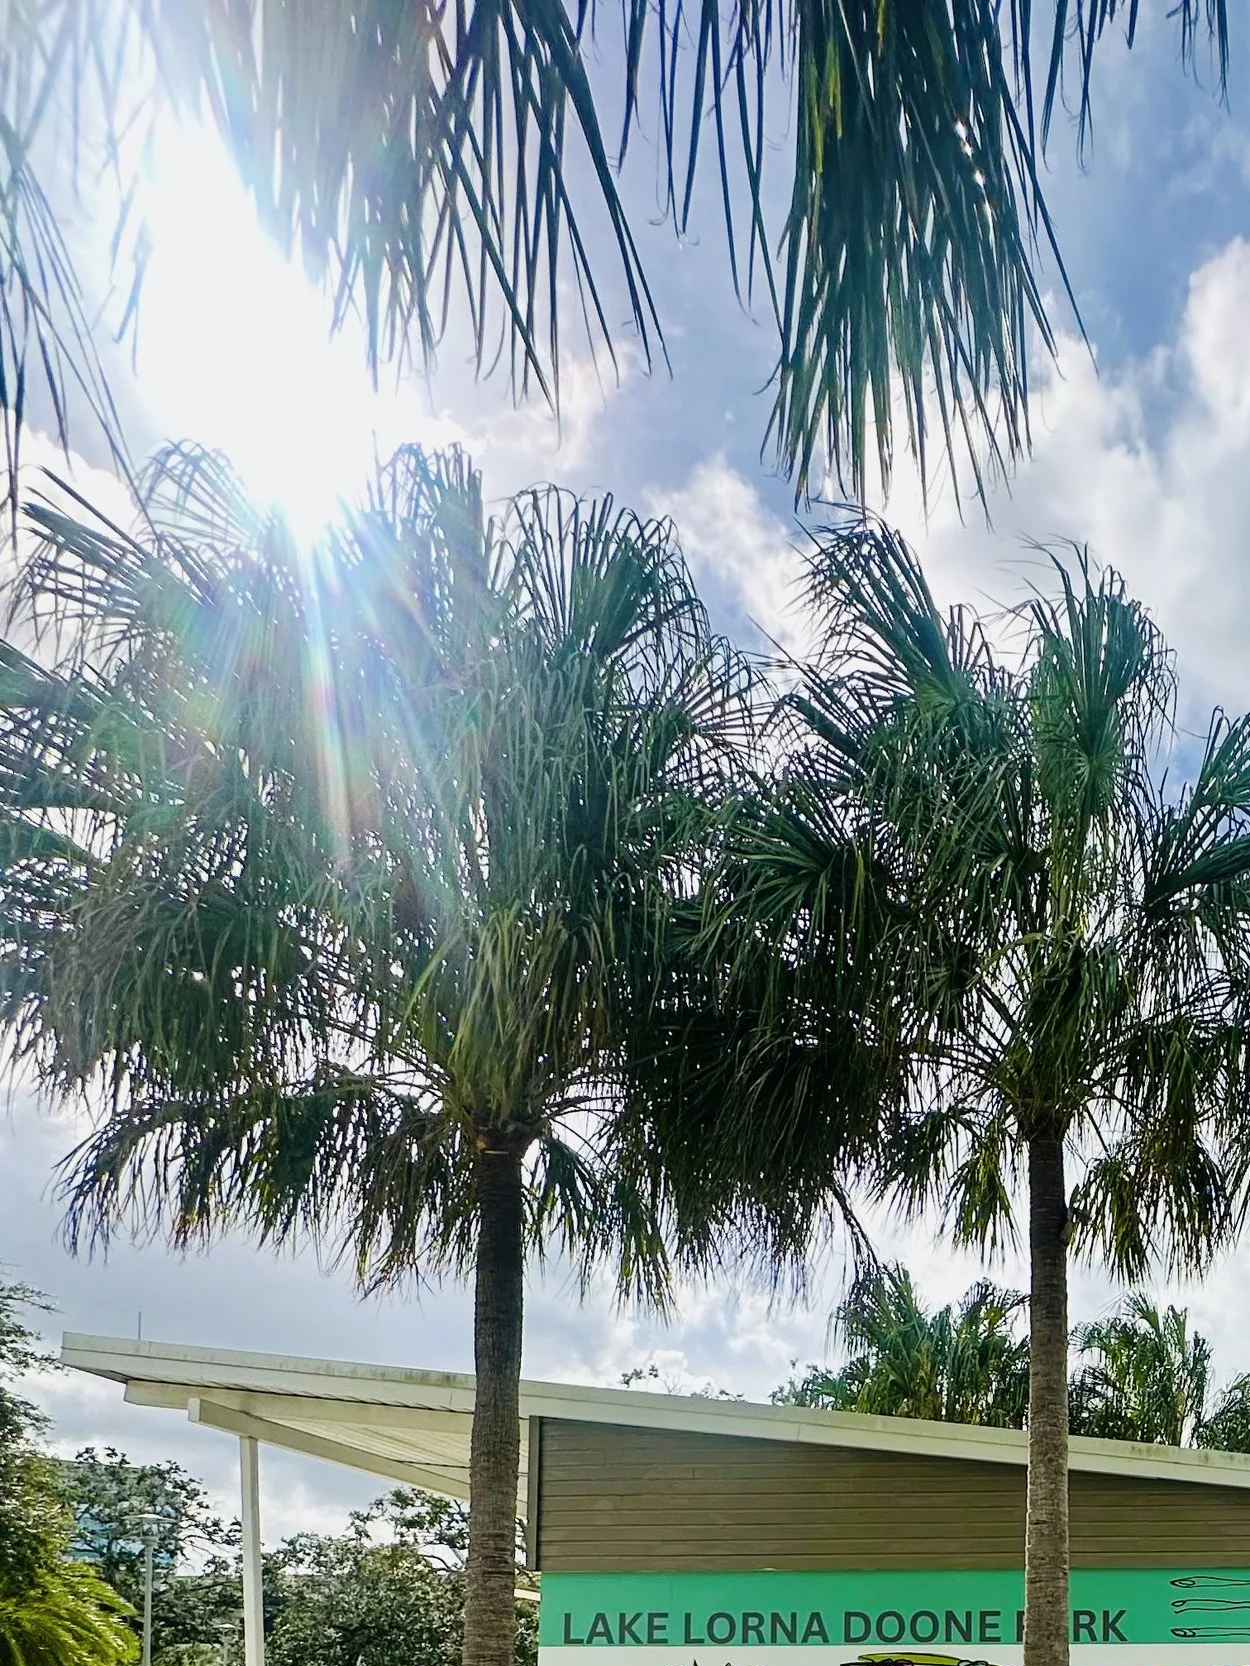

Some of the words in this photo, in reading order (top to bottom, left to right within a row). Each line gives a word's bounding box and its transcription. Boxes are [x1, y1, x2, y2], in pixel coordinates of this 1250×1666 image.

[563, 1612, 669, 1645] LAKE
[684, 1611, 830, 1644] LORNA
[843, 1610, 1002, 1643] DOONE
[1016, 1609, 1128, 1642] RK
